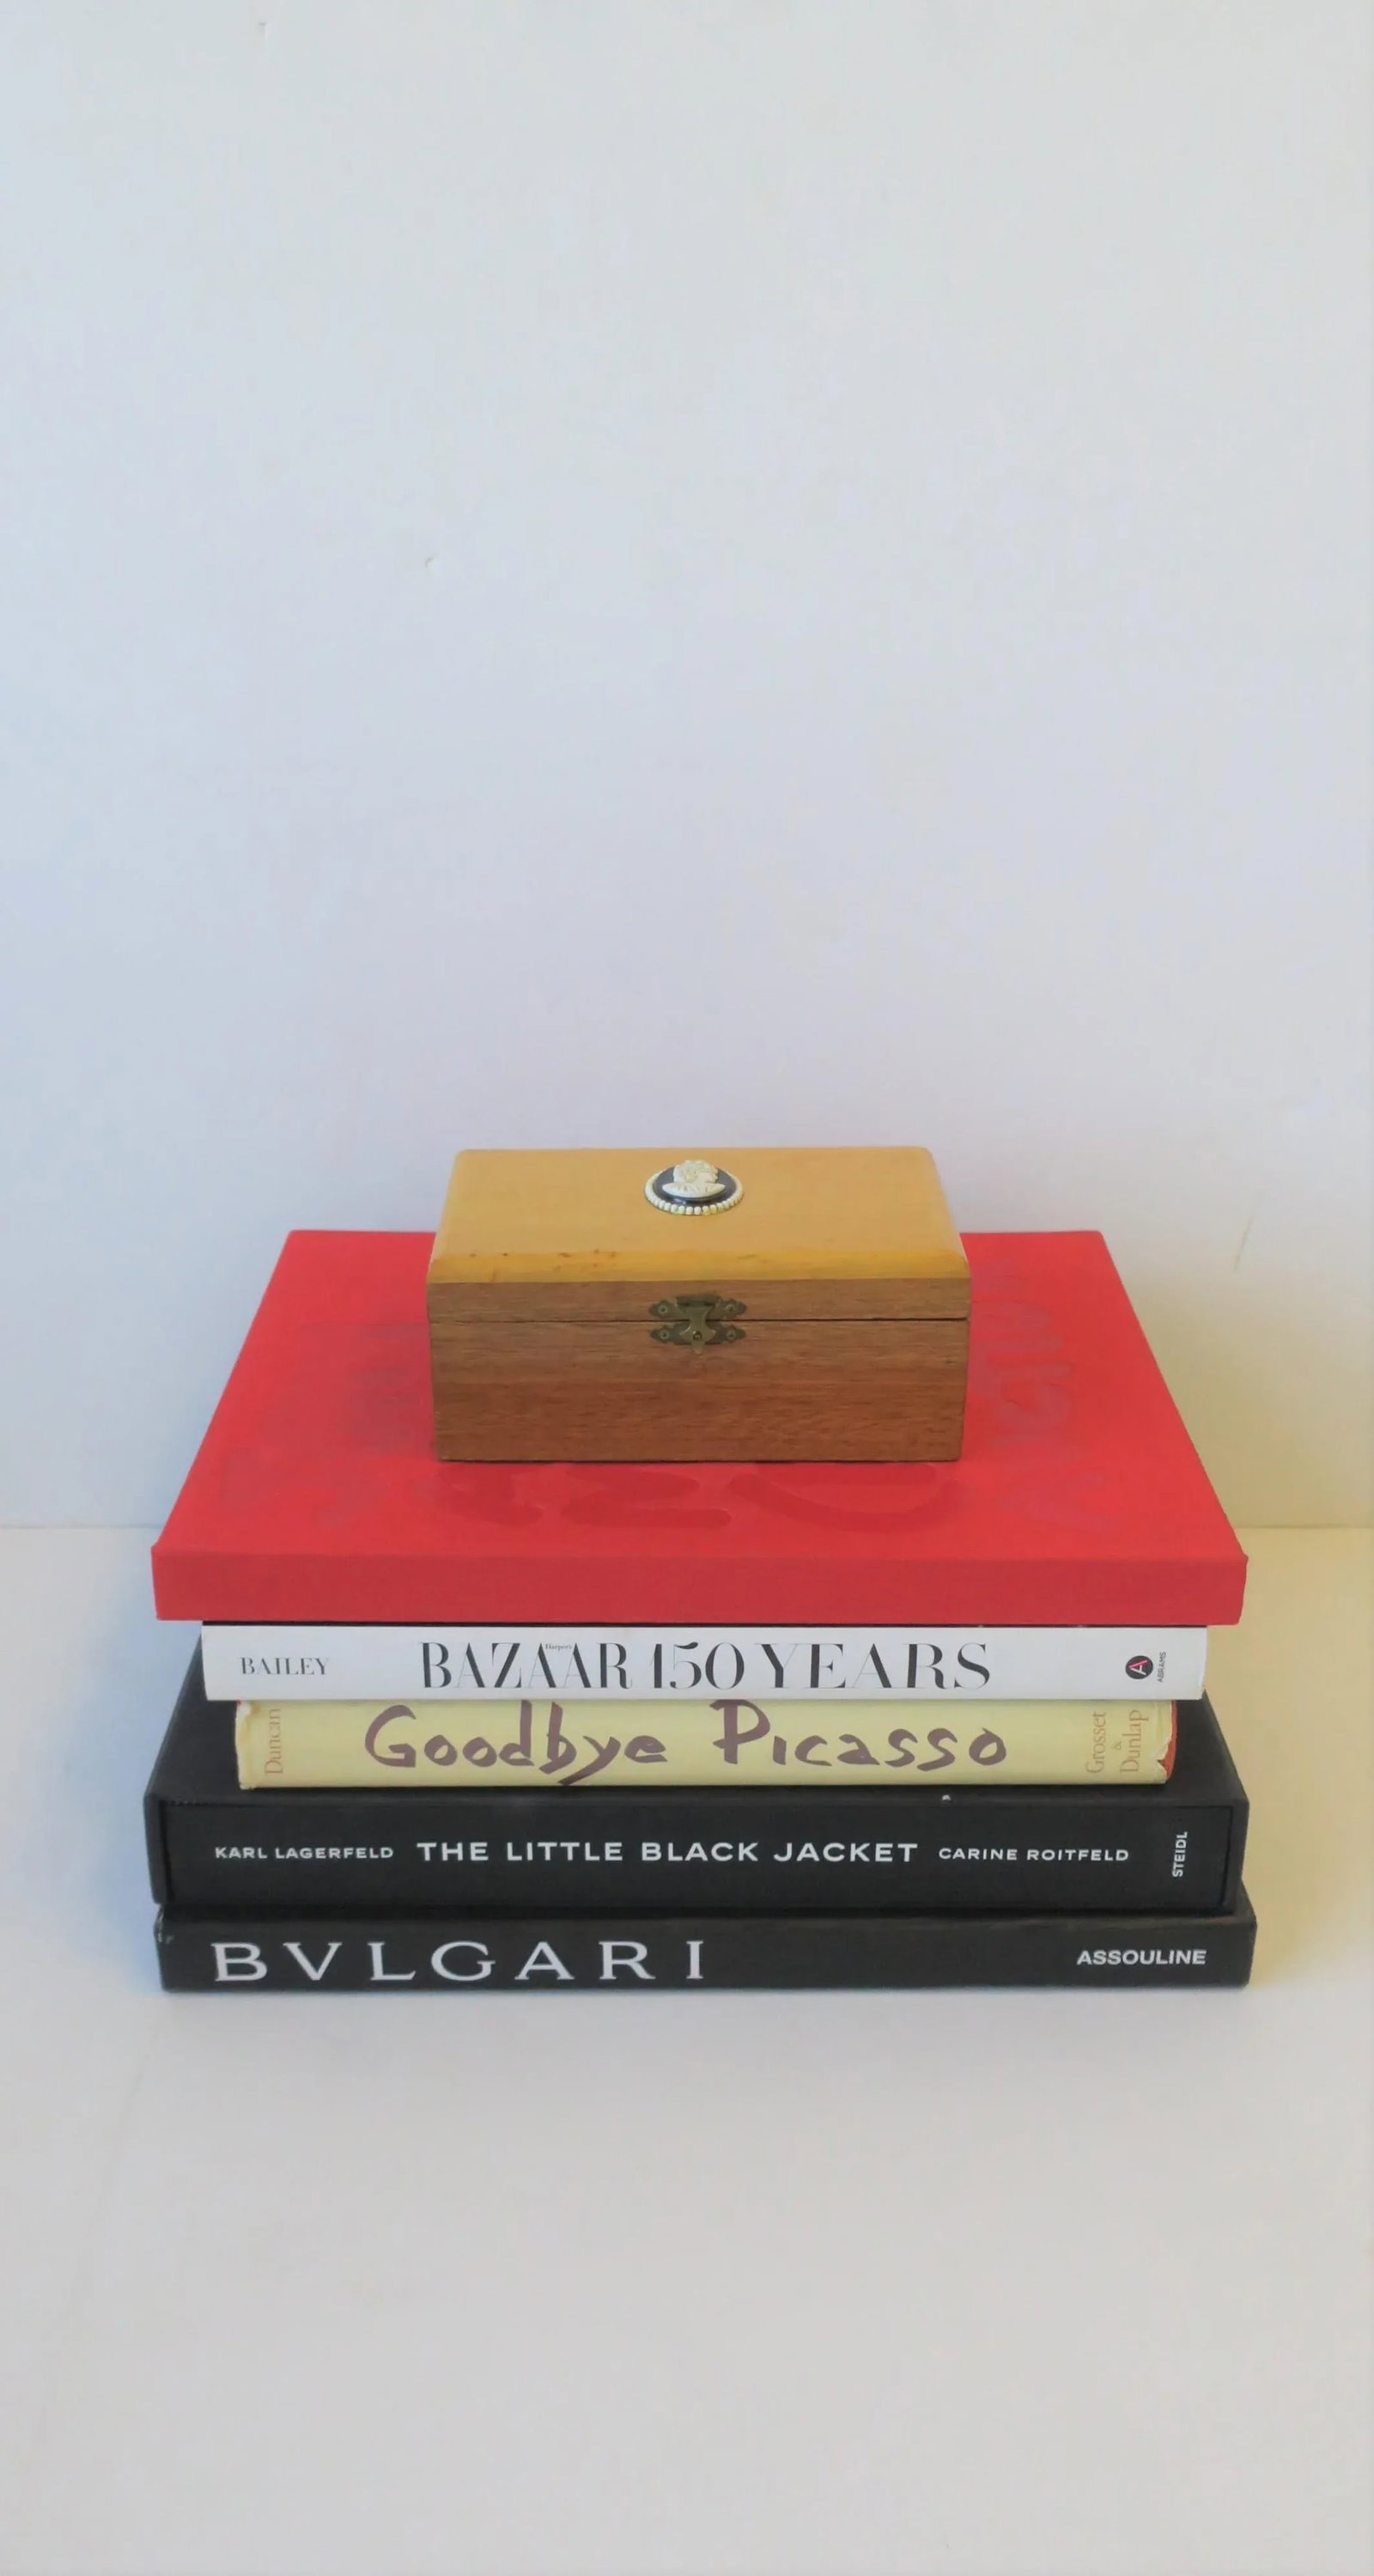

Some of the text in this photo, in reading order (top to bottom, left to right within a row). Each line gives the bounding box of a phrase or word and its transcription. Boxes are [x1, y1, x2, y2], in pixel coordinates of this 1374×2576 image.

[240, 1656, 329, 1676] BAILEY
[420, 1641, 991, 1690] BAZAAR 150 YEARS
[1156, 1650, 1167, 1684] ABRAMS
[264, 1708, 284, 1775] Duncan
[364, 1699, 1007, 1785] Goodbye Picasso
[1085, 1710, 1107, 1774] Grosset
[1120, 1708, 1149, 1774] Dunlap
[215, 1846, 394, 1860] KARL LAGERFELD
[416, 1841, 918, 1863] THE LITTLE BLACK JACKET
[938, 1847, 1129, 1861] CARINE ROITFELD
[1171, 1830, 1189, 1878] STEIDL
[210, 1940, 704, 1982] BVLGARI
[1076, 1948, 1207, 1965] ASSOULINE
